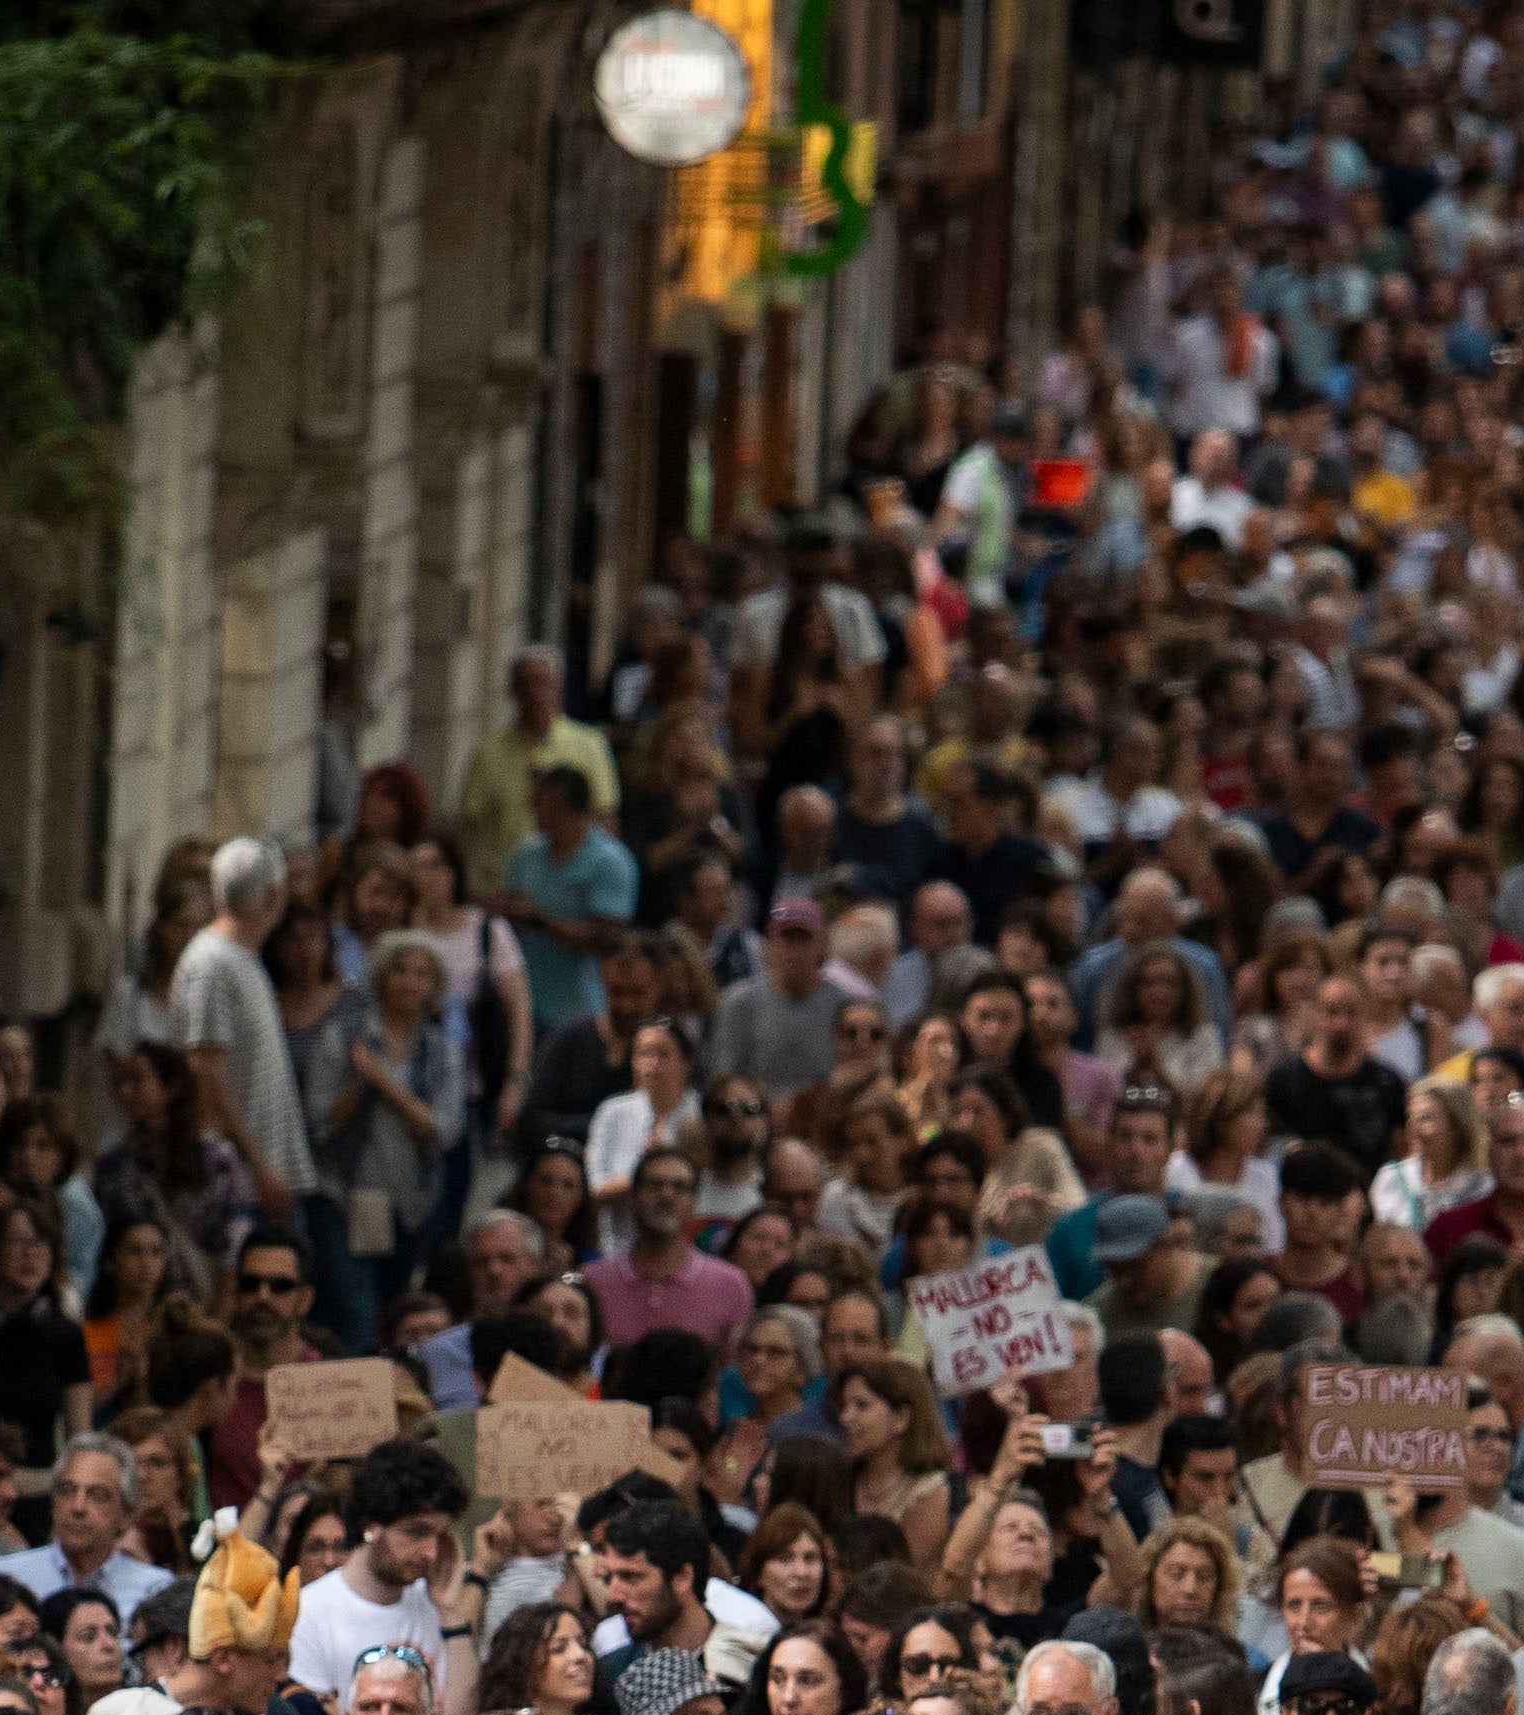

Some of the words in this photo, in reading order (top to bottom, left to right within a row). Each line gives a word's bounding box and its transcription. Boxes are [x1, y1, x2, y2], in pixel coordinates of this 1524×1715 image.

[912, 1257, 1049, 1319] MALLORCA
[1307, 1367, 1464, 1408] ESTIMAM
[1309, 1417, 1357, 1465] CA
